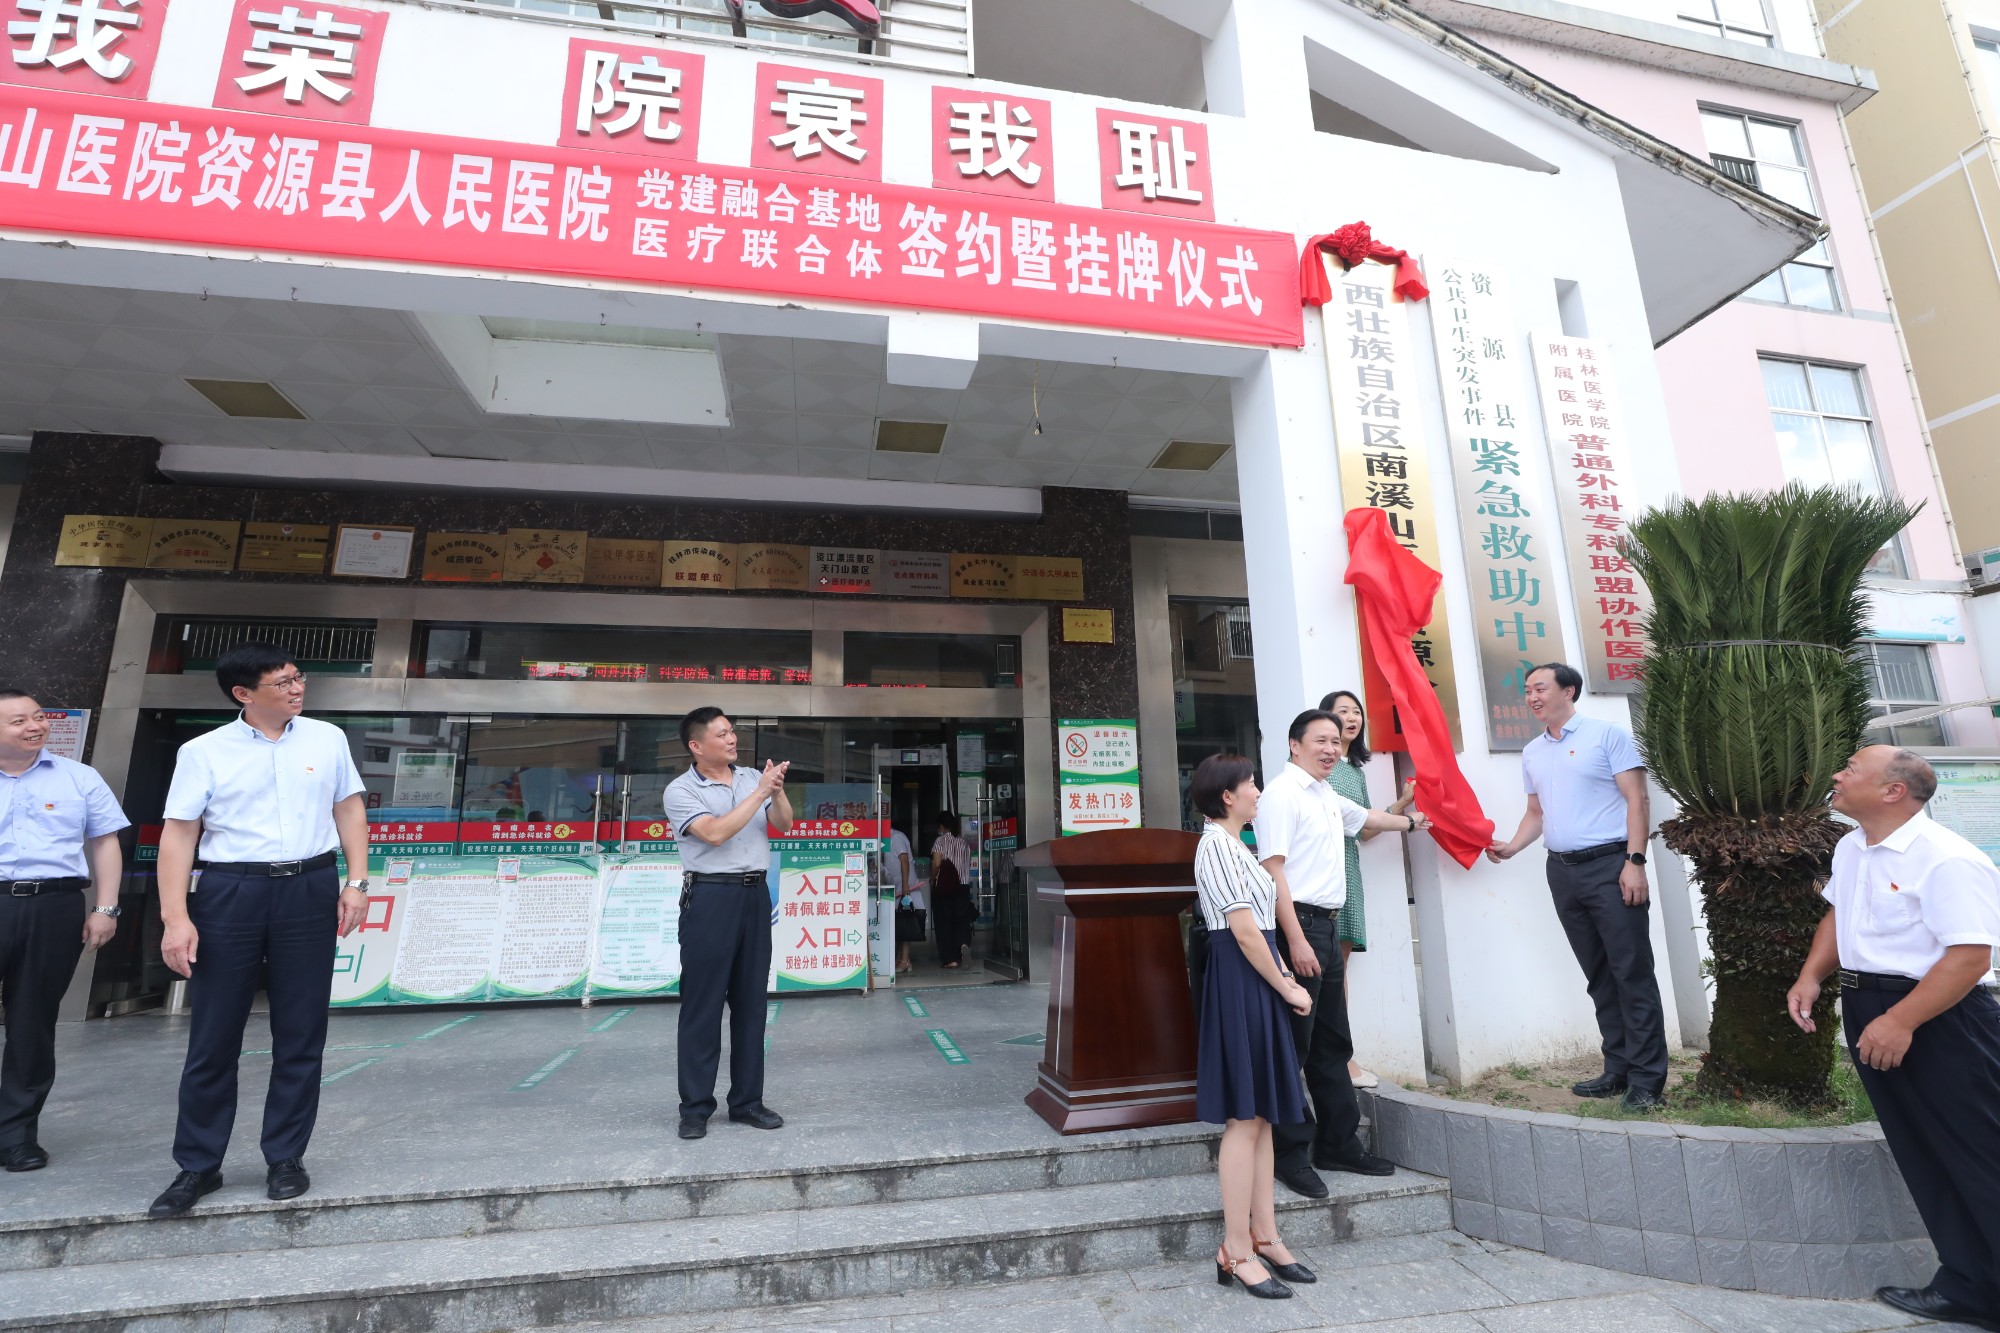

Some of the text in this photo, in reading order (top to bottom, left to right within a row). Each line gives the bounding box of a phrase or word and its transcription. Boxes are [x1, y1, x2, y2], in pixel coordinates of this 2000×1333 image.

[0, 106, 612, 243] 山医院资源县人民医院
[636, 168, 882, 233] 党建融合基地
[632, 217, 882, 280] 医疗联合体
[898, 202, 1263, 317] 签约暨挂牌仪式
[1442, 267, 1487, 428] 公共卫生突发事件
[1471, 271, 1516, 429] 资源县
[1549, 343, 1584, 427] 附属医院
[1575, 346, 1611, 430] 桂林医学院
[445, 555, 484, 565] 成员单位
[816, 552, 875, 564] 资江漂流景区
[1569, 433, 1648, 681] 普通外科专科联盟协作医院
[674, 572, 723, 583] 联盟单位
[820, 564, 870, 575] 天门山景区
[1068, 792, 1134, 810] 发热门诊
[492, 824, 552, 832] 胸痛患者
[492, 831, 552, 840] 请到急诊科就诊
[795, 873, 843, 897] 入口
[784, 900, 862, 917] 请佩戴口罩
[795, 926, 842, 949] 入口
[822, 953, 863, 969] 体温检测处
